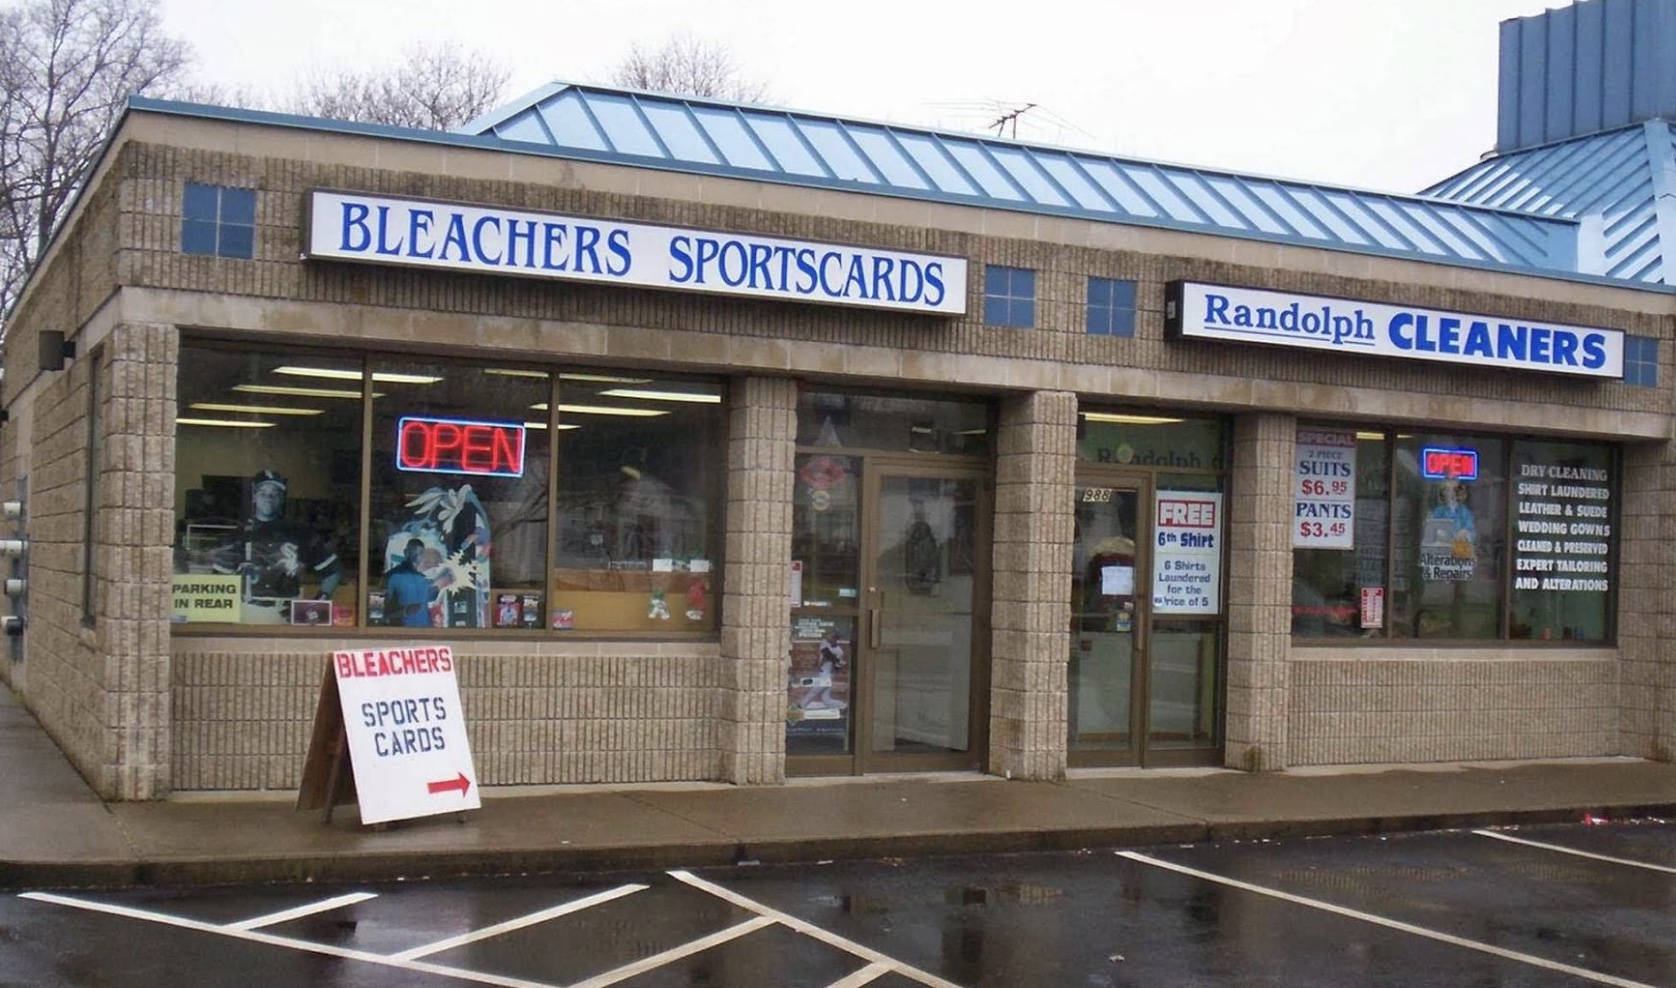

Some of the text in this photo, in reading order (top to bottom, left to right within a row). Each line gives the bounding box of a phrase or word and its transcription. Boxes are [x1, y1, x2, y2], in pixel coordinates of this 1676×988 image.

[339, 202, 946, 306] BLEACHERS SPORTSCARDS
[1204, 294, 1606, 369] Randolph CLEANERS
[401, 421, 523, 474] OPEN
[1298, 431, 1354, 448] SPECIAL
[1097, 447, 1200, 468] Rndolph
[1426, 453, 1475, 476] OPEN
[1299, 460, 1351, 477] SUITS
[1521, 464, 1608, 481] DRY CLEANING
[1085, 489, 1110, 501] 988
[1302, 479, 1347, 496] $6.95
[1518, 483, 1610, 500] SHIRT LAUNDERED
[1160, 502, 1214, 526] FREE
[1296, 502, 1352, 519] PANTS
[1519, 502, 1607, 518] LEATHER & SUEDE
[1300, 521, 1346, 538] $3.45
[1518, 521, 1610, 537] WEDDING GOWNS
[1158, 532, 1214, 548] 6th Shirt
[1517, 540, 1608, 555] CLEANED & PRESERVED
[1164, 560, 1206, 571] 6 Shirts
[1433, 566, 1473, 581] Repairs
[1516, 559, 1607, 573] EXPERT TAILORING
[1158, 573, 1211, 584] Laundered
[1515, 577, 1608, 591] AND ALTERATIONS
[172, 584, 237, 595] PARKING
[1167, 584, 1202, 594] for the
[174, 599, 233, 609] IN REAR
[1188, 597, 1199, 607] of
[1201, 597, 1209, 607] 5
[336, 648, 452, 678] BLEACHERS
[361, 697, 446, 727] SPORTS
[374, 727, 446, 757] CARDS
